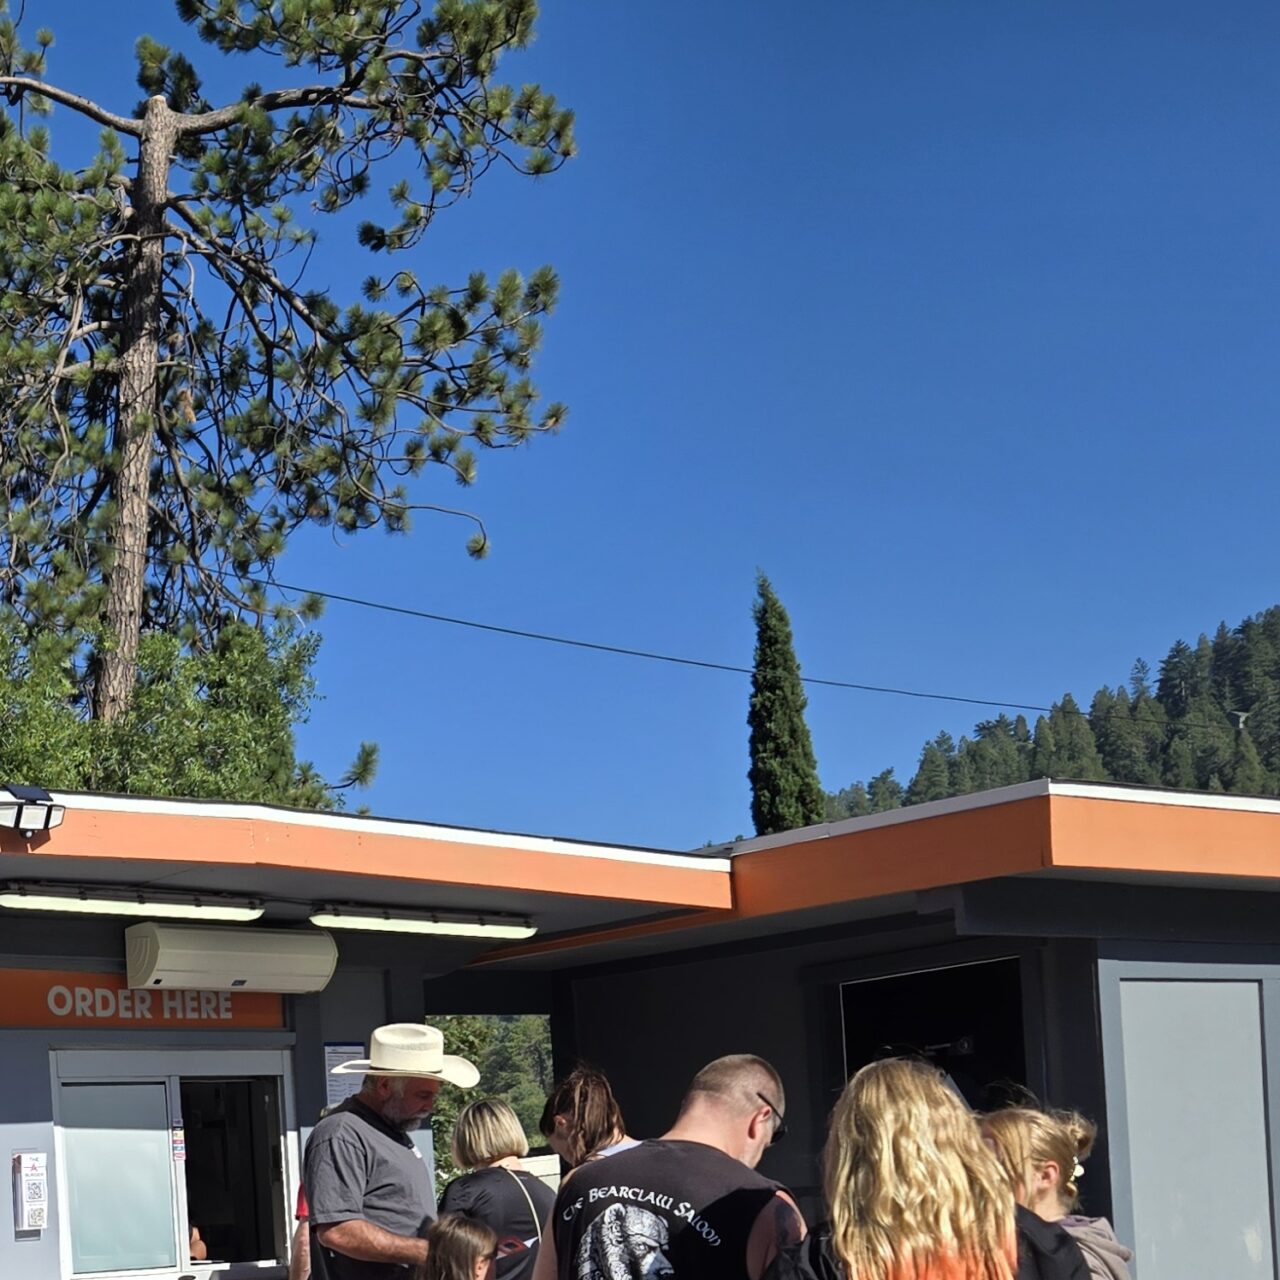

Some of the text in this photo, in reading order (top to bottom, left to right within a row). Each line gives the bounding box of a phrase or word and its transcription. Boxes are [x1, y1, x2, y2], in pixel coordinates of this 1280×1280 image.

[47, 985, 233, 1019] ORDER HERE
[588, 1185, 674, 1211] BEARCLAW
